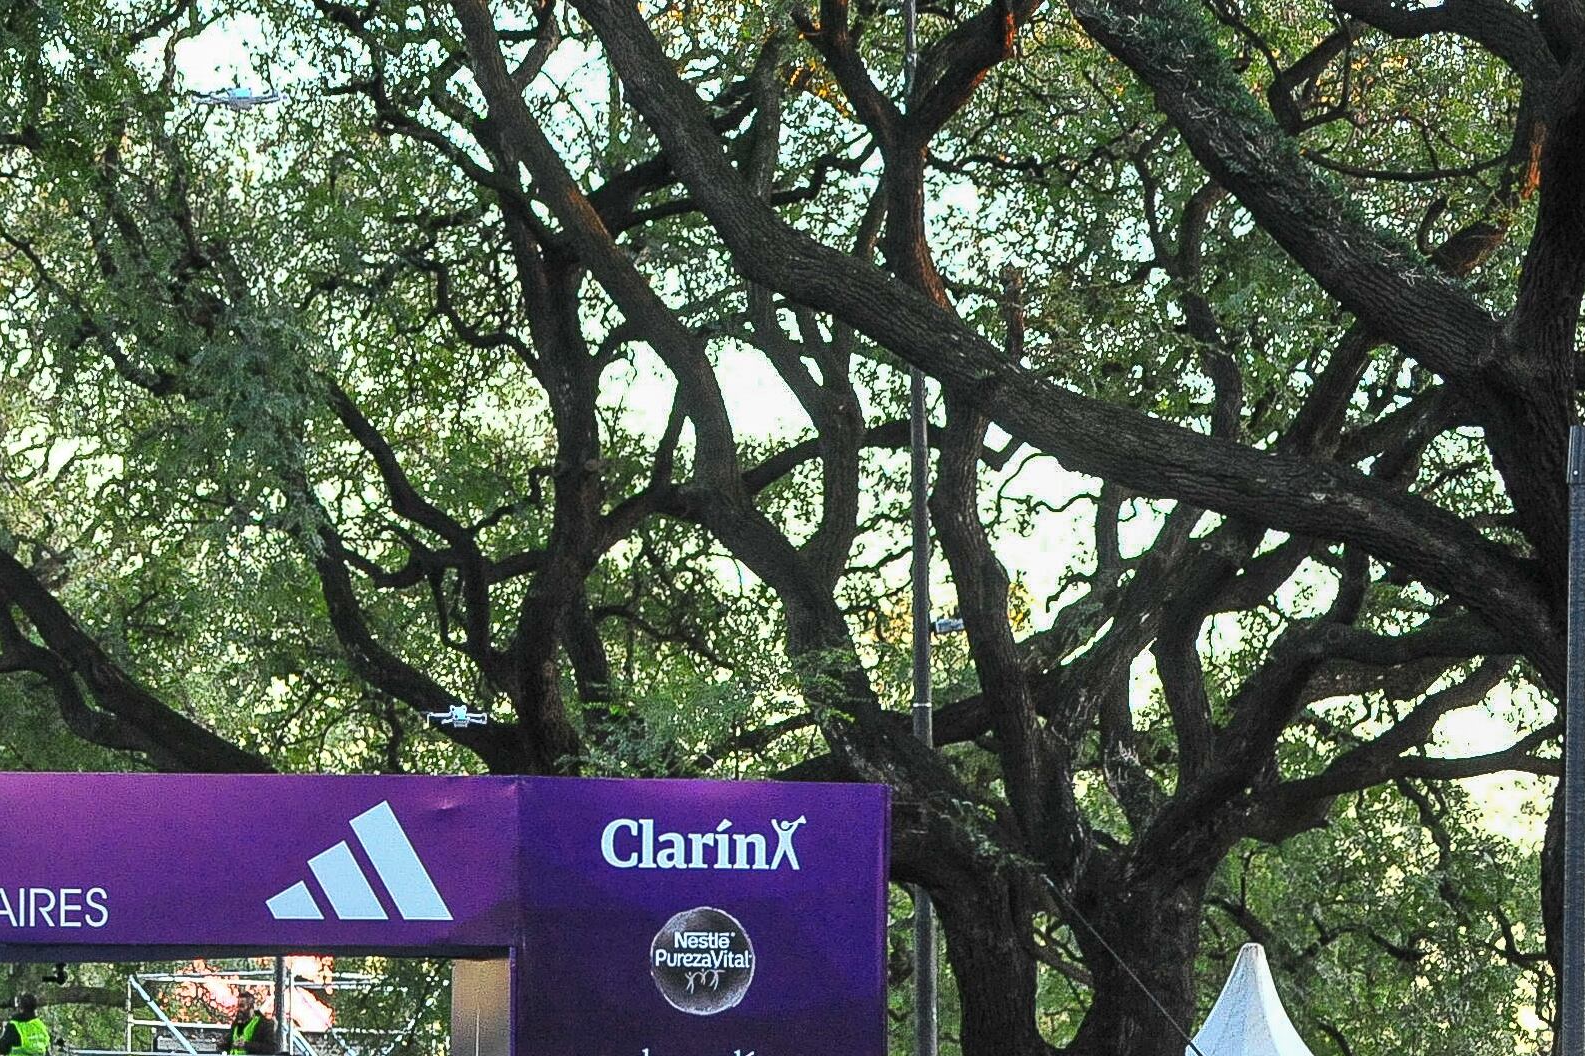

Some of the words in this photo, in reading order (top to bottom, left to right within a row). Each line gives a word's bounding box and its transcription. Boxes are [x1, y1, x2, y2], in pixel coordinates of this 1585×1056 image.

[601, 818, 770, 870] Clarín
[675, 932, 730, 949] Nestlé
[655, 949, 751, 968] PurezaVital
